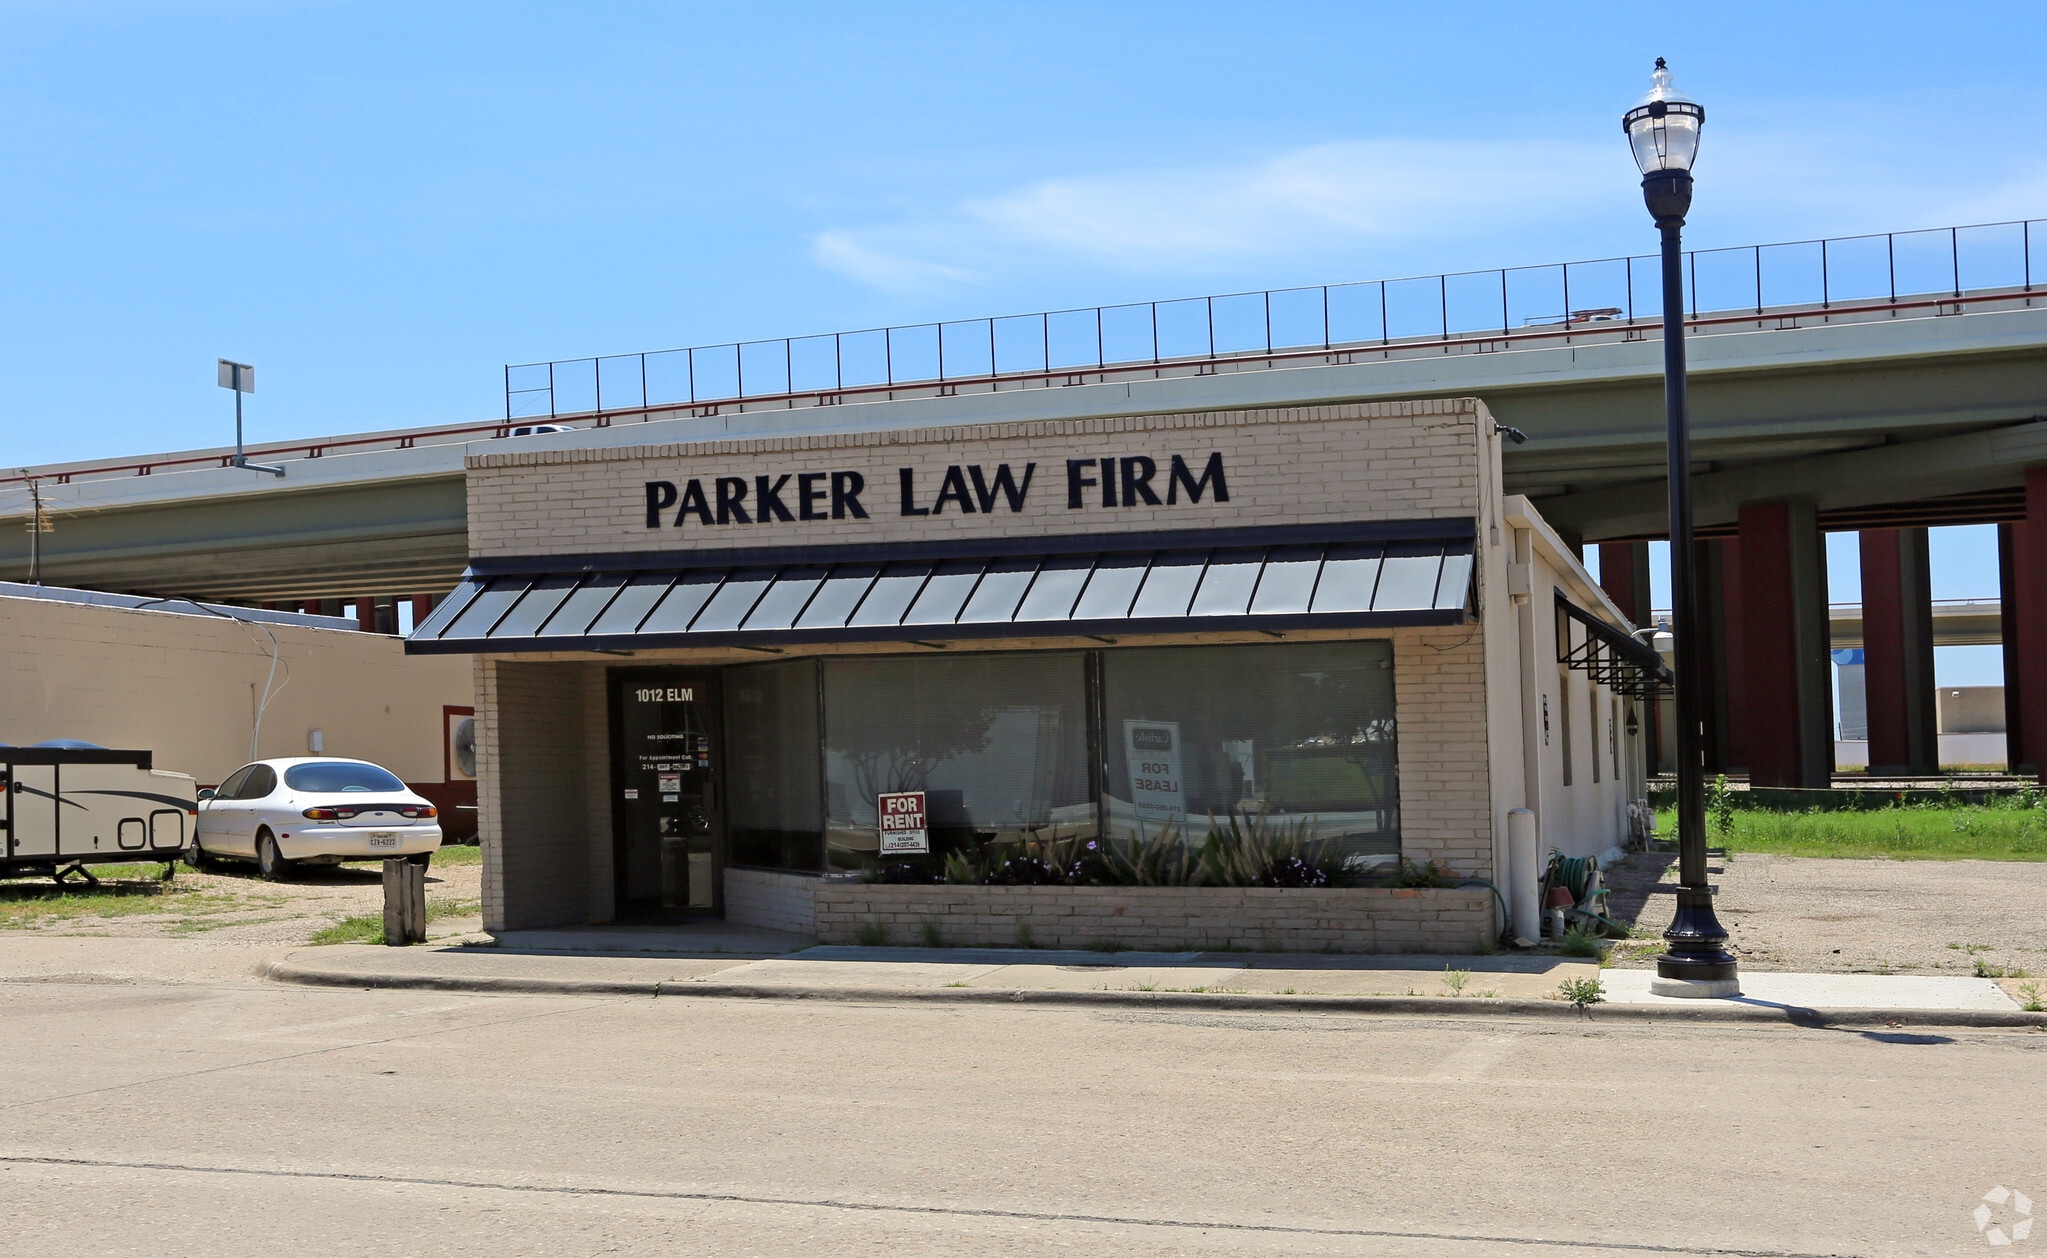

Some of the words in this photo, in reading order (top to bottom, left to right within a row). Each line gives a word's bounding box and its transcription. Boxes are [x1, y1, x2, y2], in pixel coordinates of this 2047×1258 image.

[645, 470, 870, 529] PARKER
[898, 462, 1037, 517] LAW
[1065, 451, 1231, 510] FIRM
[636, 688, 664, 702] 1012
[666, 688, 693, 702] ELM
[886, 798, 918, 813] FOR
[882, 814, 922, 829] RENT
